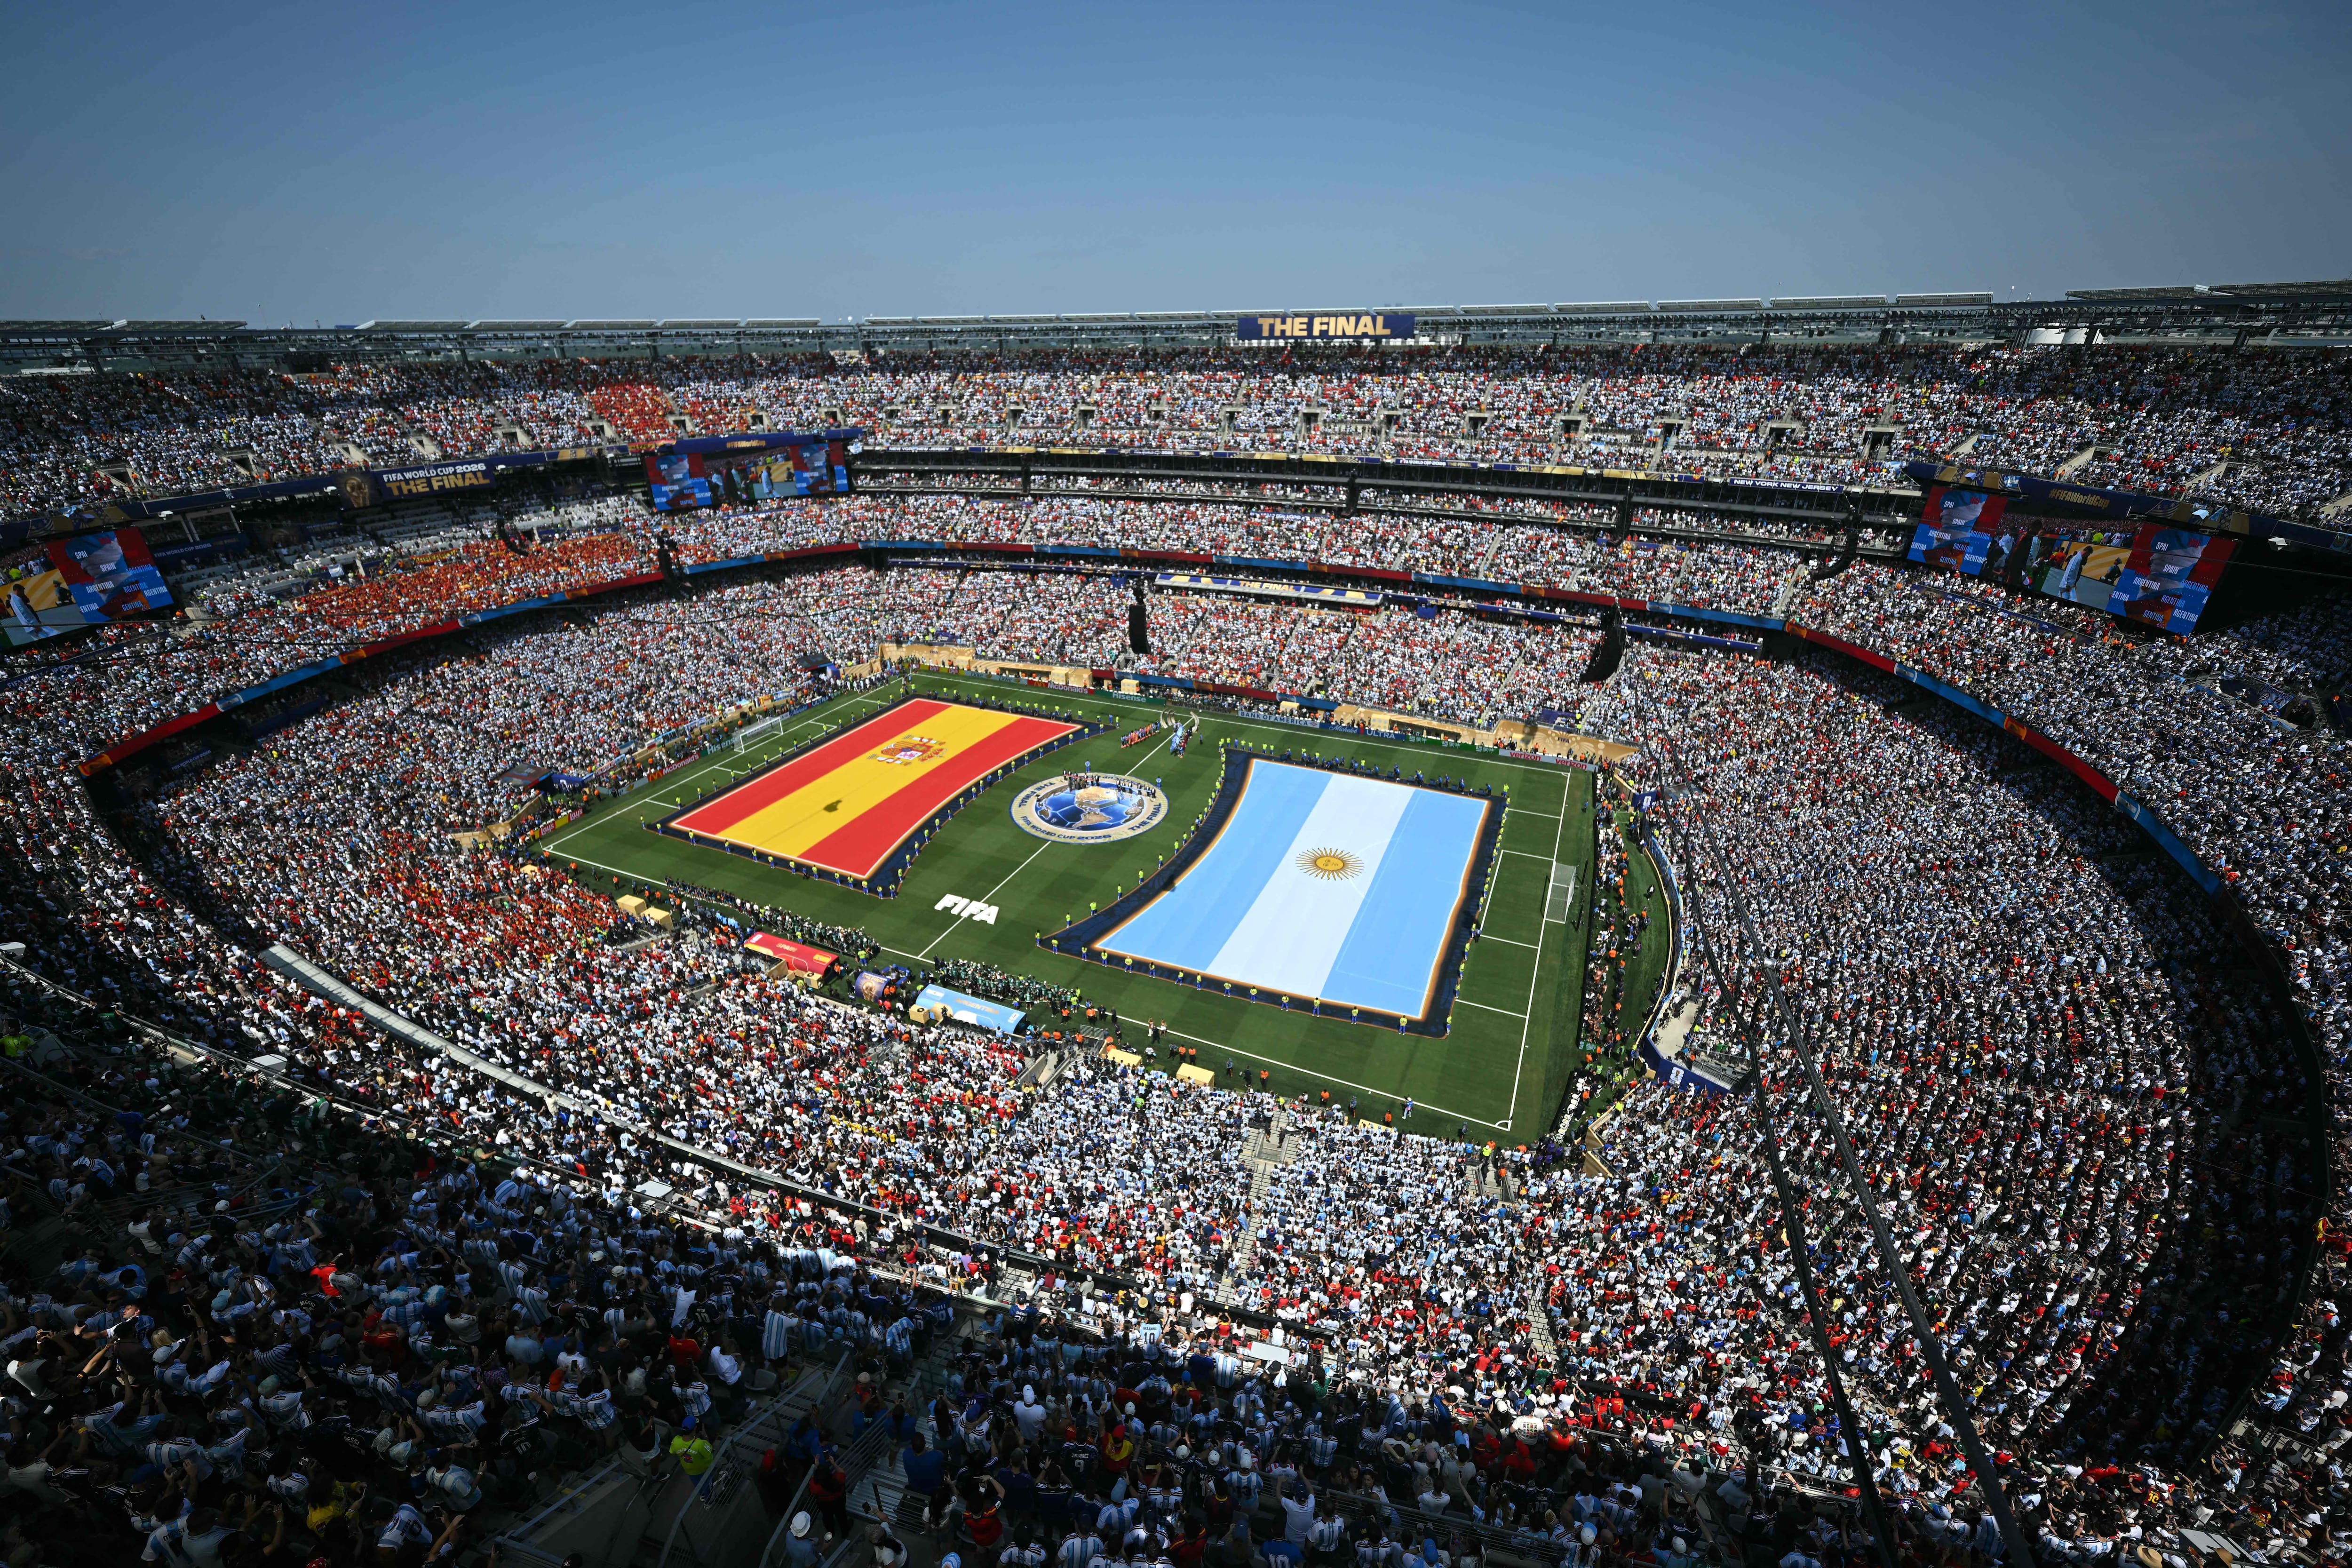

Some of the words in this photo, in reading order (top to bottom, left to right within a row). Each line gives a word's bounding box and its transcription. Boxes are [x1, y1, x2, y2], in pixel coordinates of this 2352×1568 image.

[1257, 317, 1308, 336] THE
[1313, 316, 1391, 336] FINAL
[404, 470, 437, 480] WORLD
[456, 463, 486, 473] 2026
[386, 479, 429, 496] THE
[431, 472, 490, 491] FINAL
[2049, 489, 2110, 509] #FIFAWorldCup
[1929, 530, 1951, 541] ARGENTINA
[1953, 543, 1973, 553] RGENTINA
[2156, 542, 2169, 551] SPAI
[74, 550, 87, 559] SPAI
[1964, 554, 1984, 564] RGENTINA
[1939, 557, 1957, 565] GENTINA
[100, 563, 116, 572] SPAIN
[2163, 565, 2179, 574] SPAIN
[86, 581, 114, 594] ARGENTINA
[123, 582, 148, 593] RGENTINA
[1263, 582, 1295, 592] FINAL
[2133, 577, 2161, 590] ARGENTINA
[2181, 579, 2209, 593] ARGENTINA
[143, 586, 167, 597] RGENTINA
[121, 601, 143, 612] GENTINA
[2161, 595, 2186, 608] RGENTINA
[2143, 610, 2164, 622] GENTINA
[2173, 609, 2198, 622] RGENTINA
[7, 679, 22, 688] FIFA
[1048, 682, 1088, 694] McDonald's
[812, 695, 828, 706] ULTRA
[1112, 692, 1146, 702] Hisense
[1273, 716, 1308, 726] AMERICA
[1329, 724, 1358, 734] Michelob
[1367, 729, 1395, 739] ULTRA
[1510, 751, 1541, 761] verizon
[663, 754, 699, 775] McDonald's
[1555, 758, 1587, 770] verizon
[1038, 782, 1055, 792] THE
[1018, 790, 1036, 808] FINAL
[570, 808, 583, 821] Lay's
[1127, 821, 1148, 831] THE
[1148, 803, 1161, 824] FINAL
[541, 823, 554, 836] Lay's
[1021, 816, 1032, 826] FIFA
[1032, 824, 1056, 837] WORLD
[934, 893, 999, 925] FIFA
[776, 943, 798, 952] SPAIN
[955, 998, 999, 1015] ARGENTINA
[576, 1317, 590, 1329] 10
[695, 1313, 710, 1323] 10
[913, 1318, 924, 1330] 10
[897, 1328, 907, 1340] 10
[1144, 1332, 1155, 1345] 10
[344, 1435, 360, 1446] MESSI
[516, 1441, 532, 1455] 10
[1074, 1459, 1085, 1472] 9
[1169, 1463, 1186, 1474] MESSI
[1236, 1486, 1251, 1496] 13
[1535, 1502, 1549, 1512] 10
[400, 1519, 413, 1537] MESSI
[1268, 1553, 1290, 1568] 10
